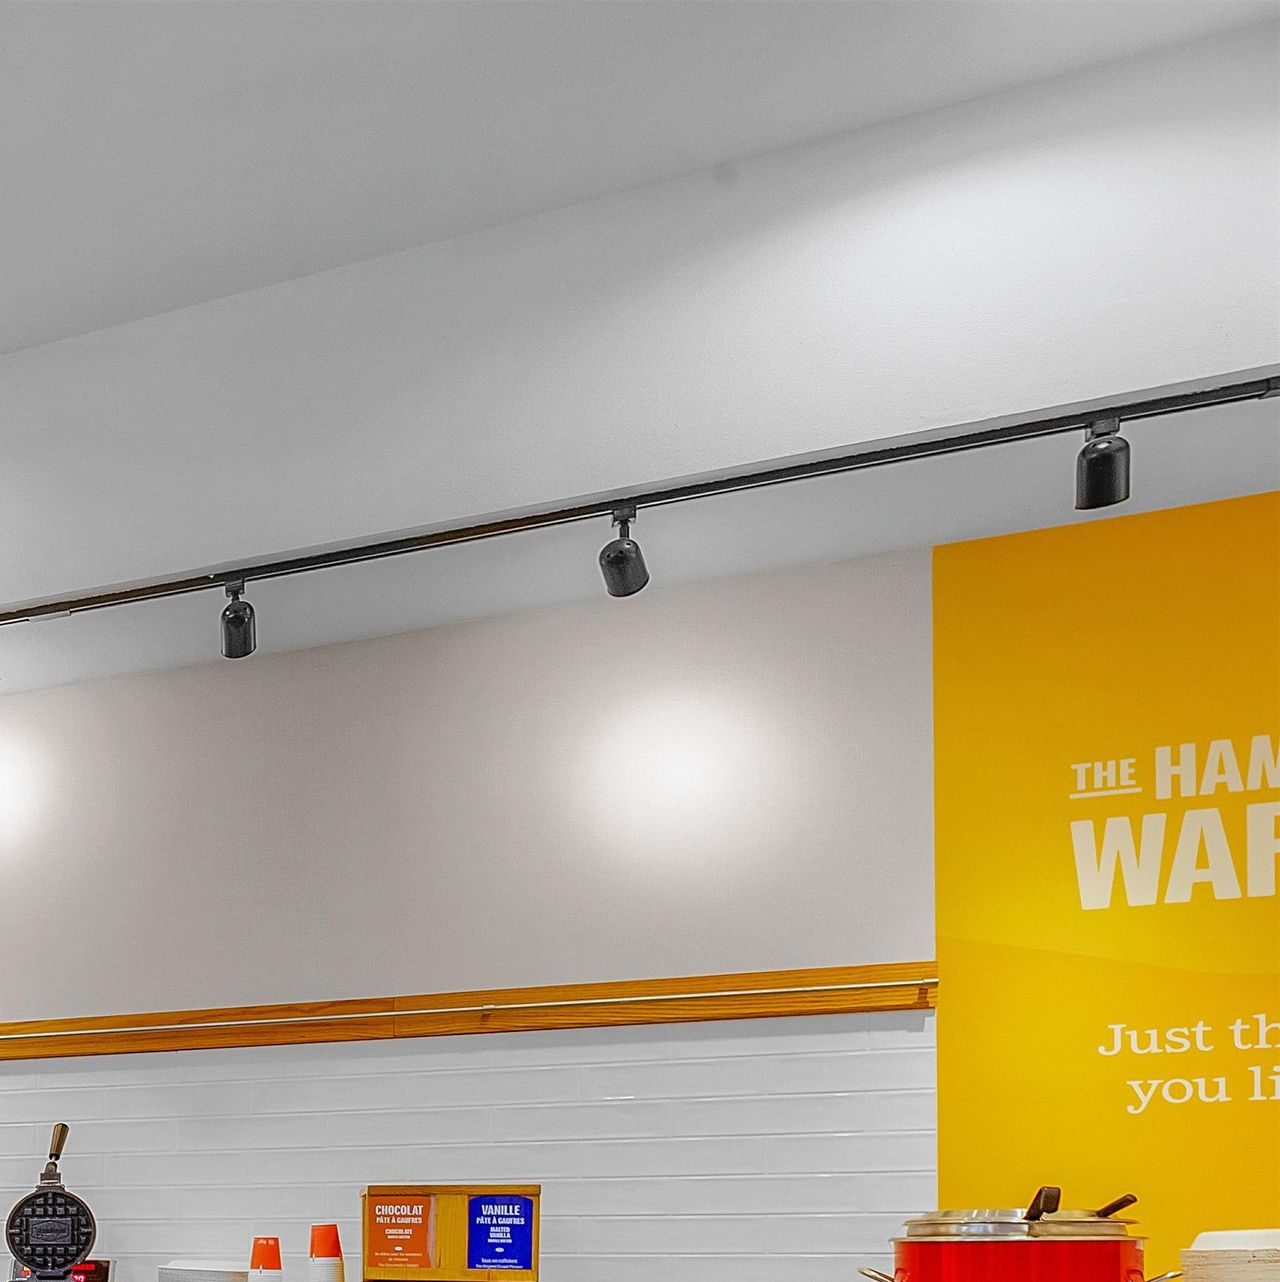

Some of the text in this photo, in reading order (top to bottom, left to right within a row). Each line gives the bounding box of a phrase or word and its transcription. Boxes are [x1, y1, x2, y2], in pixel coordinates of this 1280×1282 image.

[1070, 758, 1137, 791] THE
[1097, 1019, 1215, 1057] Just
[1125, 1075, 1233, 1115] you
[375, 1205, 424, 1216] CHOCOLAT
[481, 1204, 521, 1216] VANILLE
